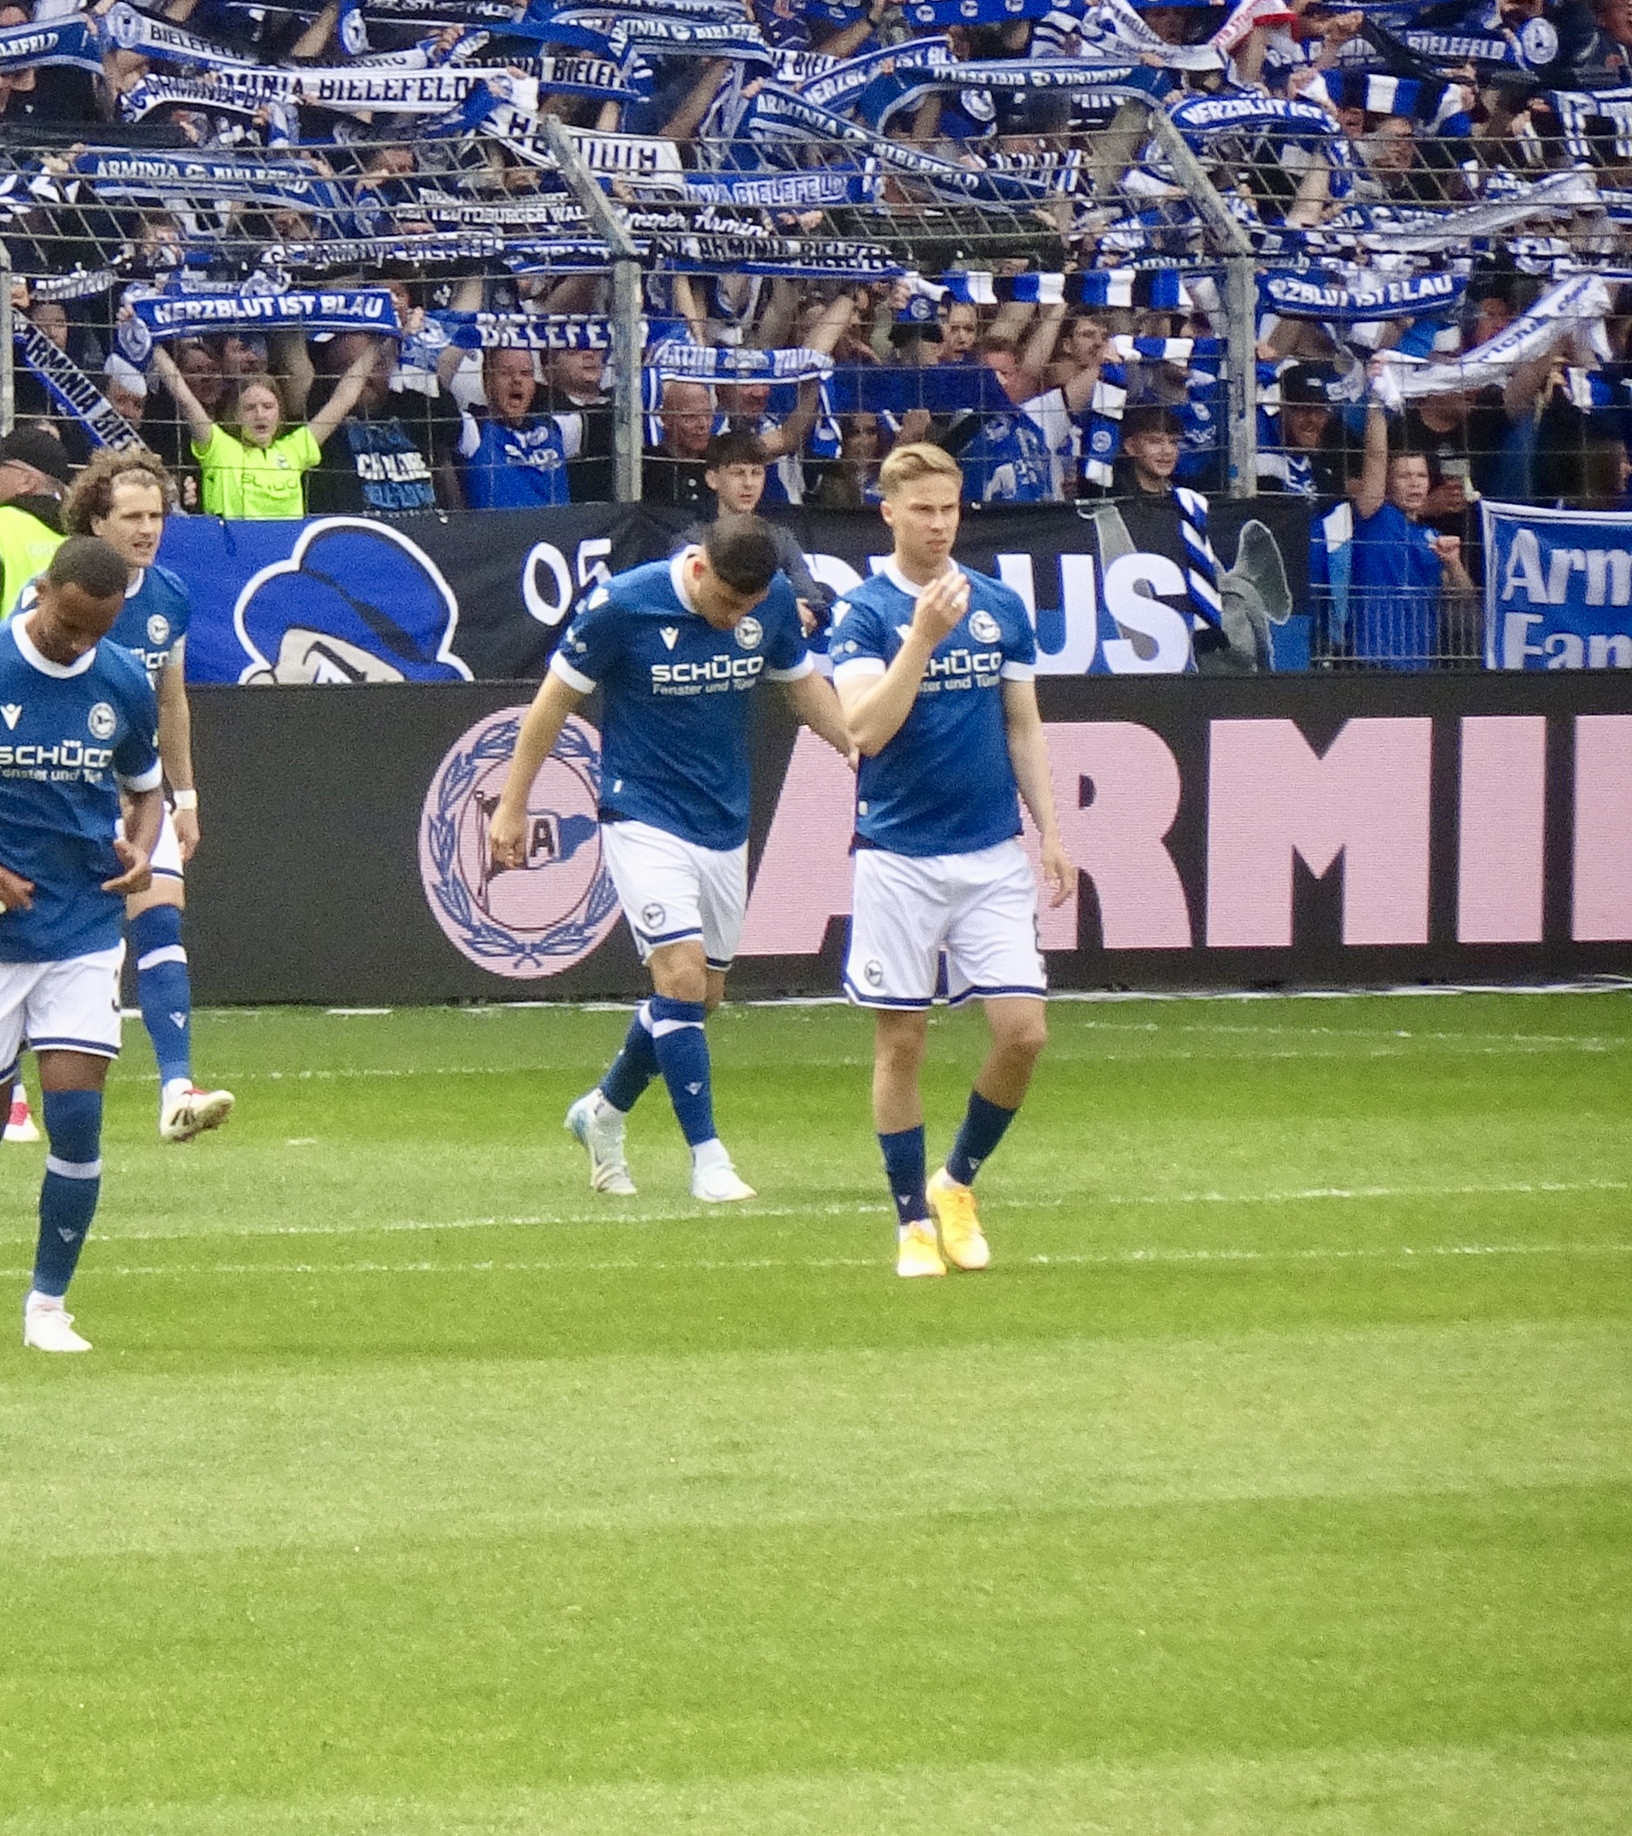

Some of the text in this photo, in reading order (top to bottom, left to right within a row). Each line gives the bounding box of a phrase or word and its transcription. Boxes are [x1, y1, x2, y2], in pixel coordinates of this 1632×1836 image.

[318, 77, 474, 103] BIELEFELD
[96, 159, 181, 185] ARMINIA
[153, 292, 384, 322] HERZBLUT IST BLAU
[651, 654, 764, 684] SCHÜCO
[652, 679, 729, 697] Fenster und
[51, 767, 81, 783] und
